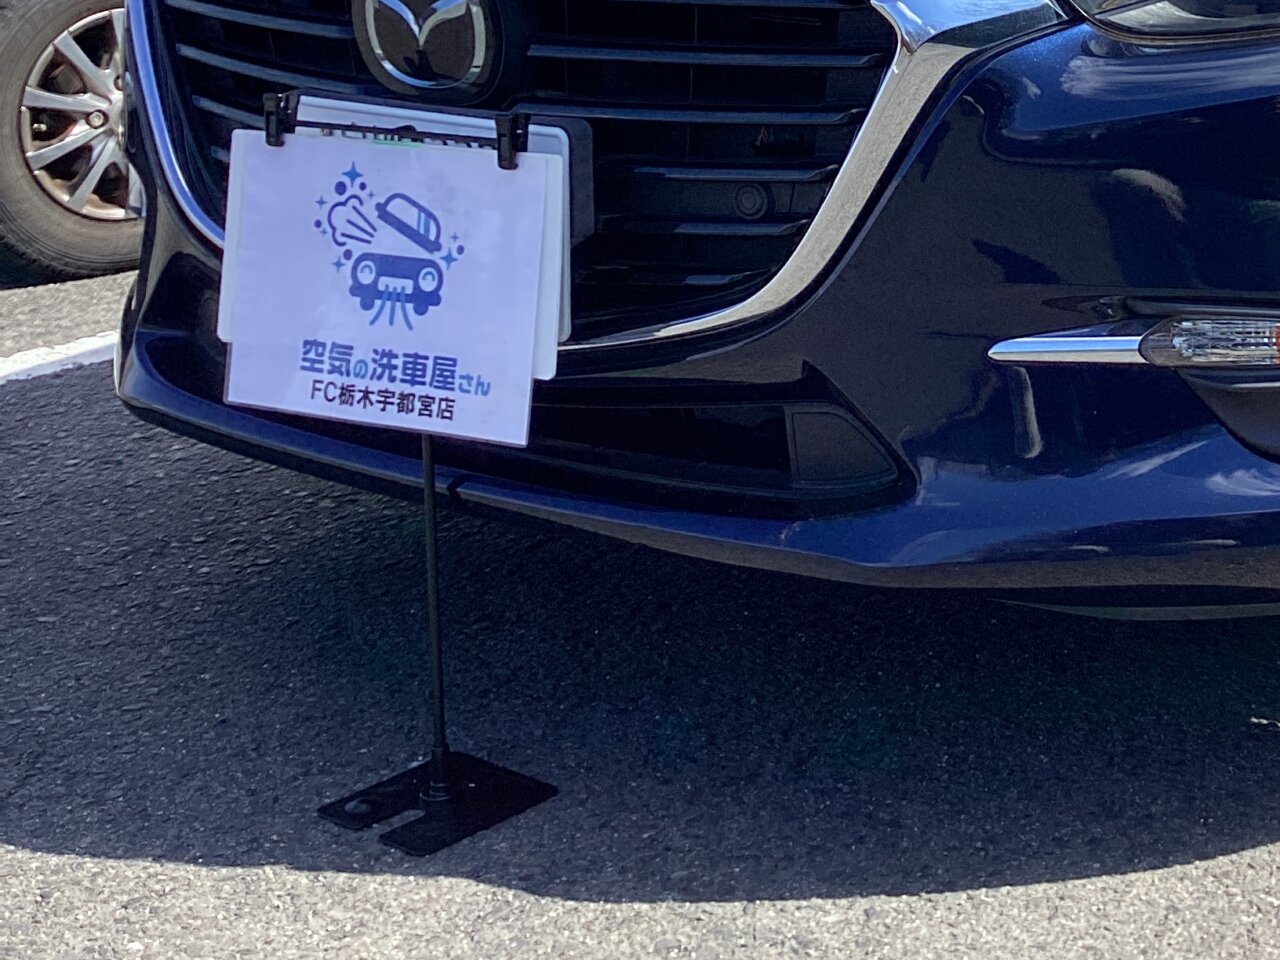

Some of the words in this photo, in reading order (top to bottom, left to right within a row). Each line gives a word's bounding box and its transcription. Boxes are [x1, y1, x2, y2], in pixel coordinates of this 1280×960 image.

[300, 339, 491, 397] 空気の洗車屋さん
[311, 379, 456, 421] FC栃木宇都宮店
